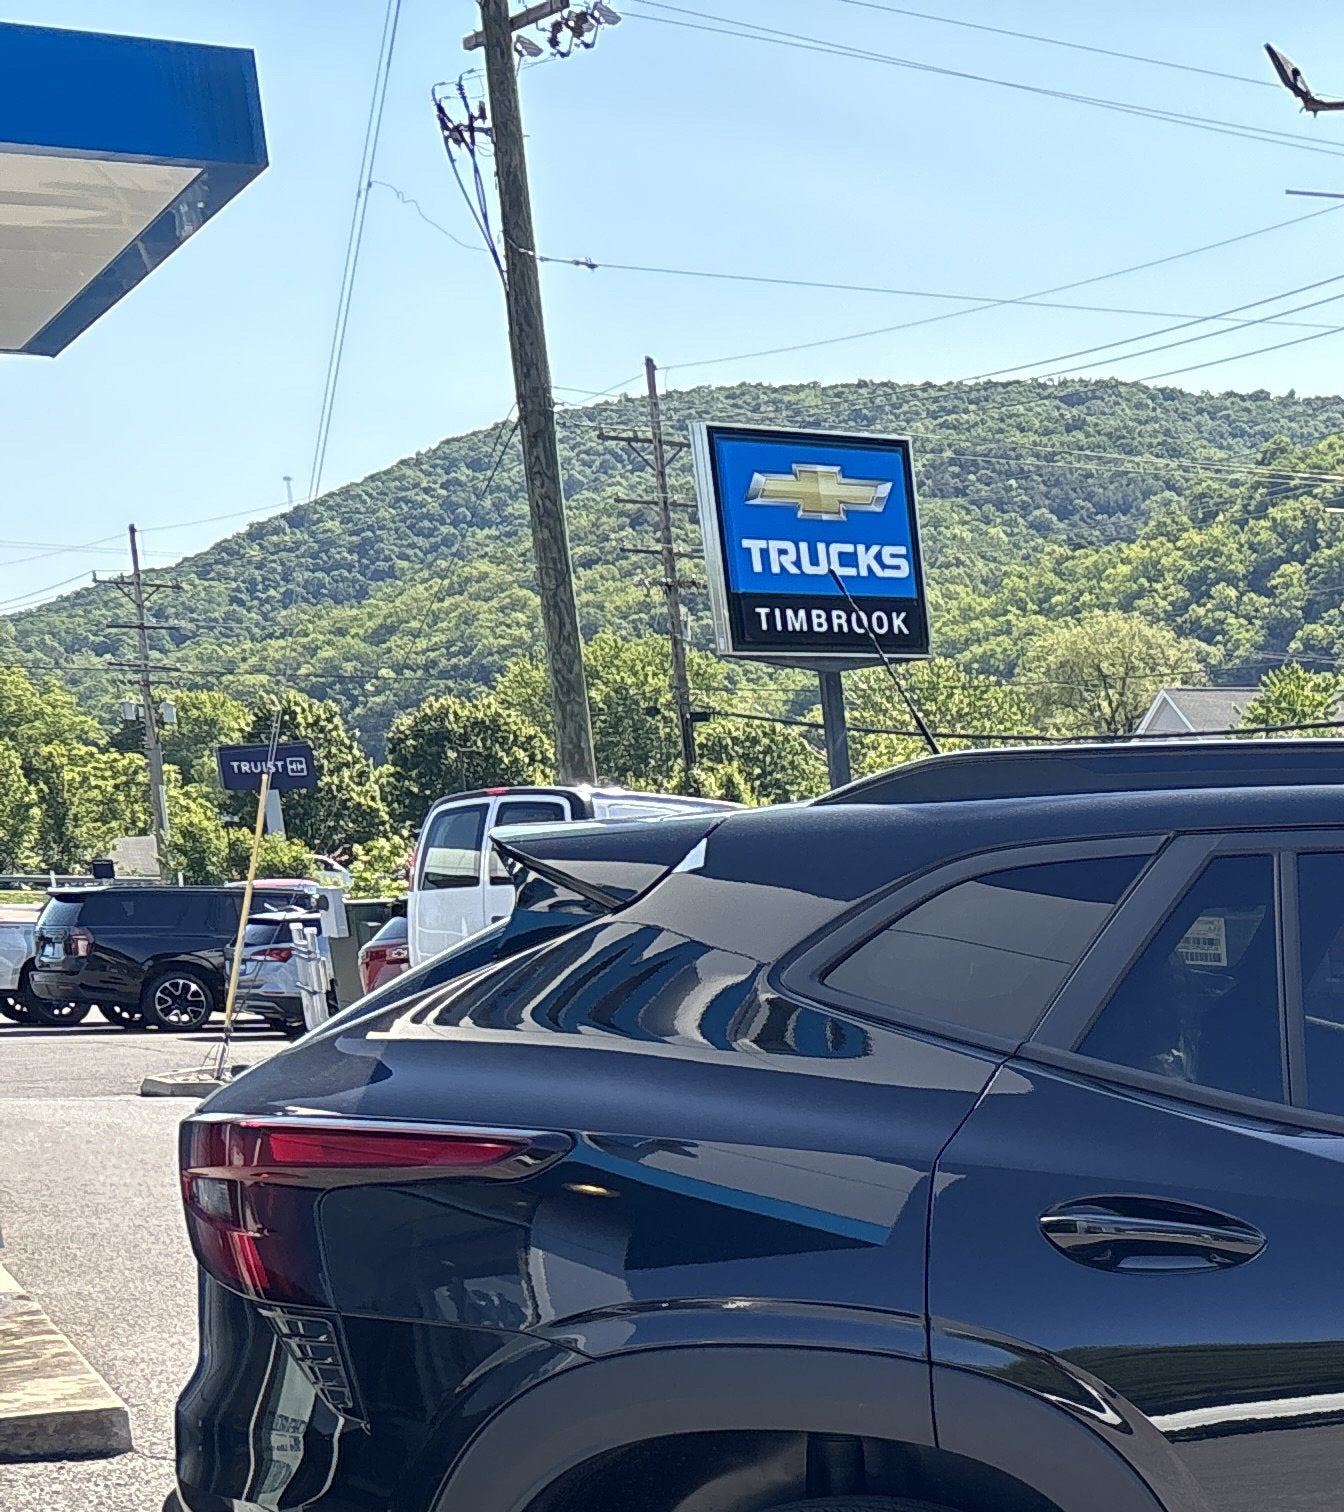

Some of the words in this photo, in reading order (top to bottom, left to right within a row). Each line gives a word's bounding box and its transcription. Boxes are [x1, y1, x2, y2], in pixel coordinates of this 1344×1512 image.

[742, 538, 910, 579] TRUCKS
[755, 607, 910, 635] TIMBROOK
[230, 760, 285, 774] TRUIST
